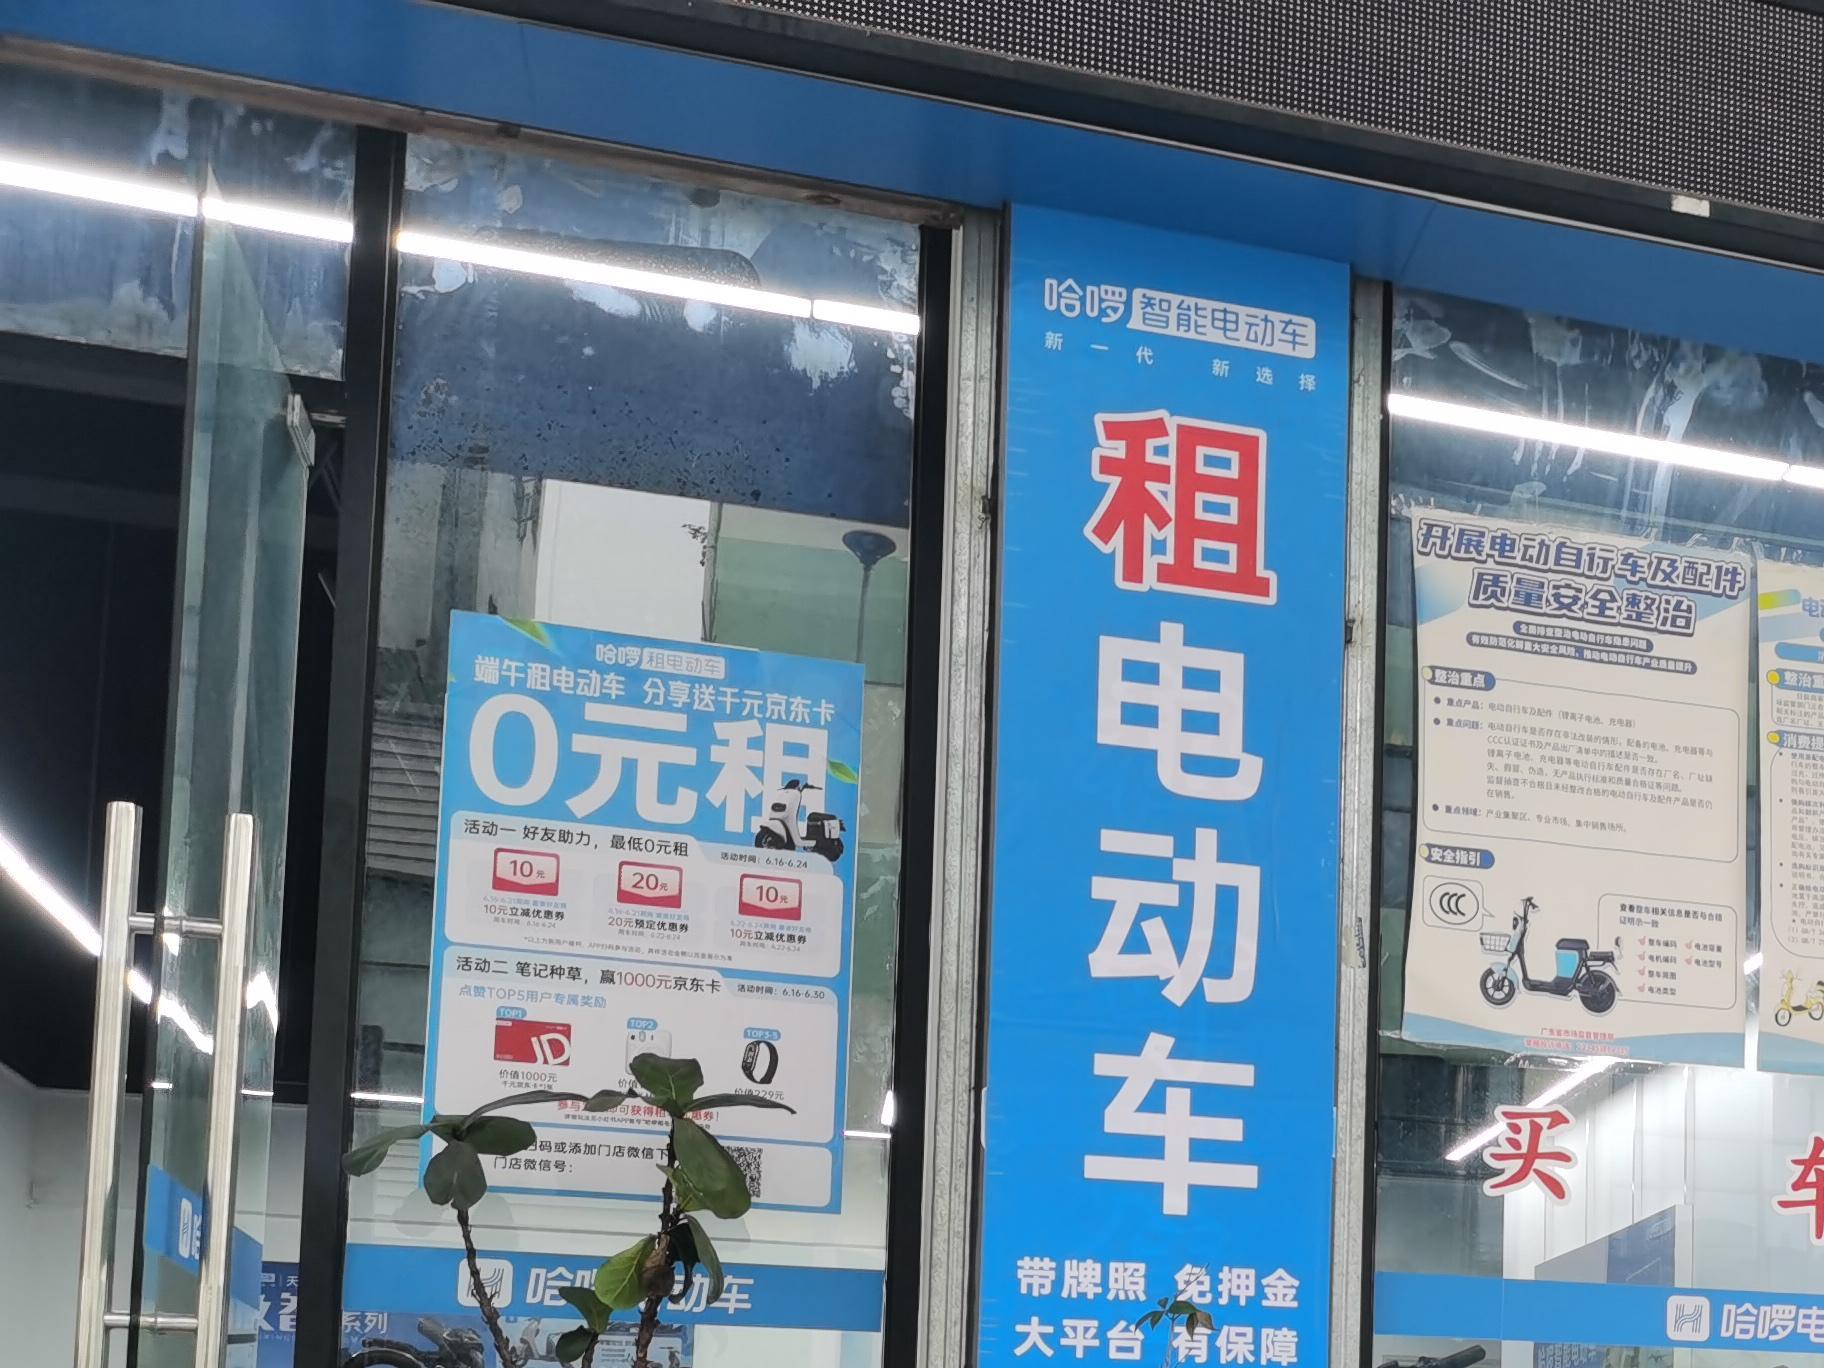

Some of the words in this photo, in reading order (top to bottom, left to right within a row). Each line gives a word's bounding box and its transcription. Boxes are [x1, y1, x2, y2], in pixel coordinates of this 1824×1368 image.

[1044, 278, 1312, 354] 哈啰智能电动车
[1044, 331, 1153, 365] 新一代
[1212, 359, 1316, 392] 新选择
[1417, 517, 1746, 597] 开展电动自行车及配件
[1468, 567, 1696, 637] 质量安全整治
[473, 655, 626, 700] 端午租电动车
[642, 677, 835, 725] 分享送千元京东卡
[469, 692, 830, 848] 0元租
[463, 818, 517, 839] 活动一
[456, 956, 508, 976] 活动二
[1486, 1106, 1576, 1201] 买
[1017, 1257, 1146, 1302] 带牌照
[1174, 1263, 1300, 1308] 免押金
[1014, 1316, 1144, 1361] 大平台
[1173, 1325, 1299, 1366] 有保障
